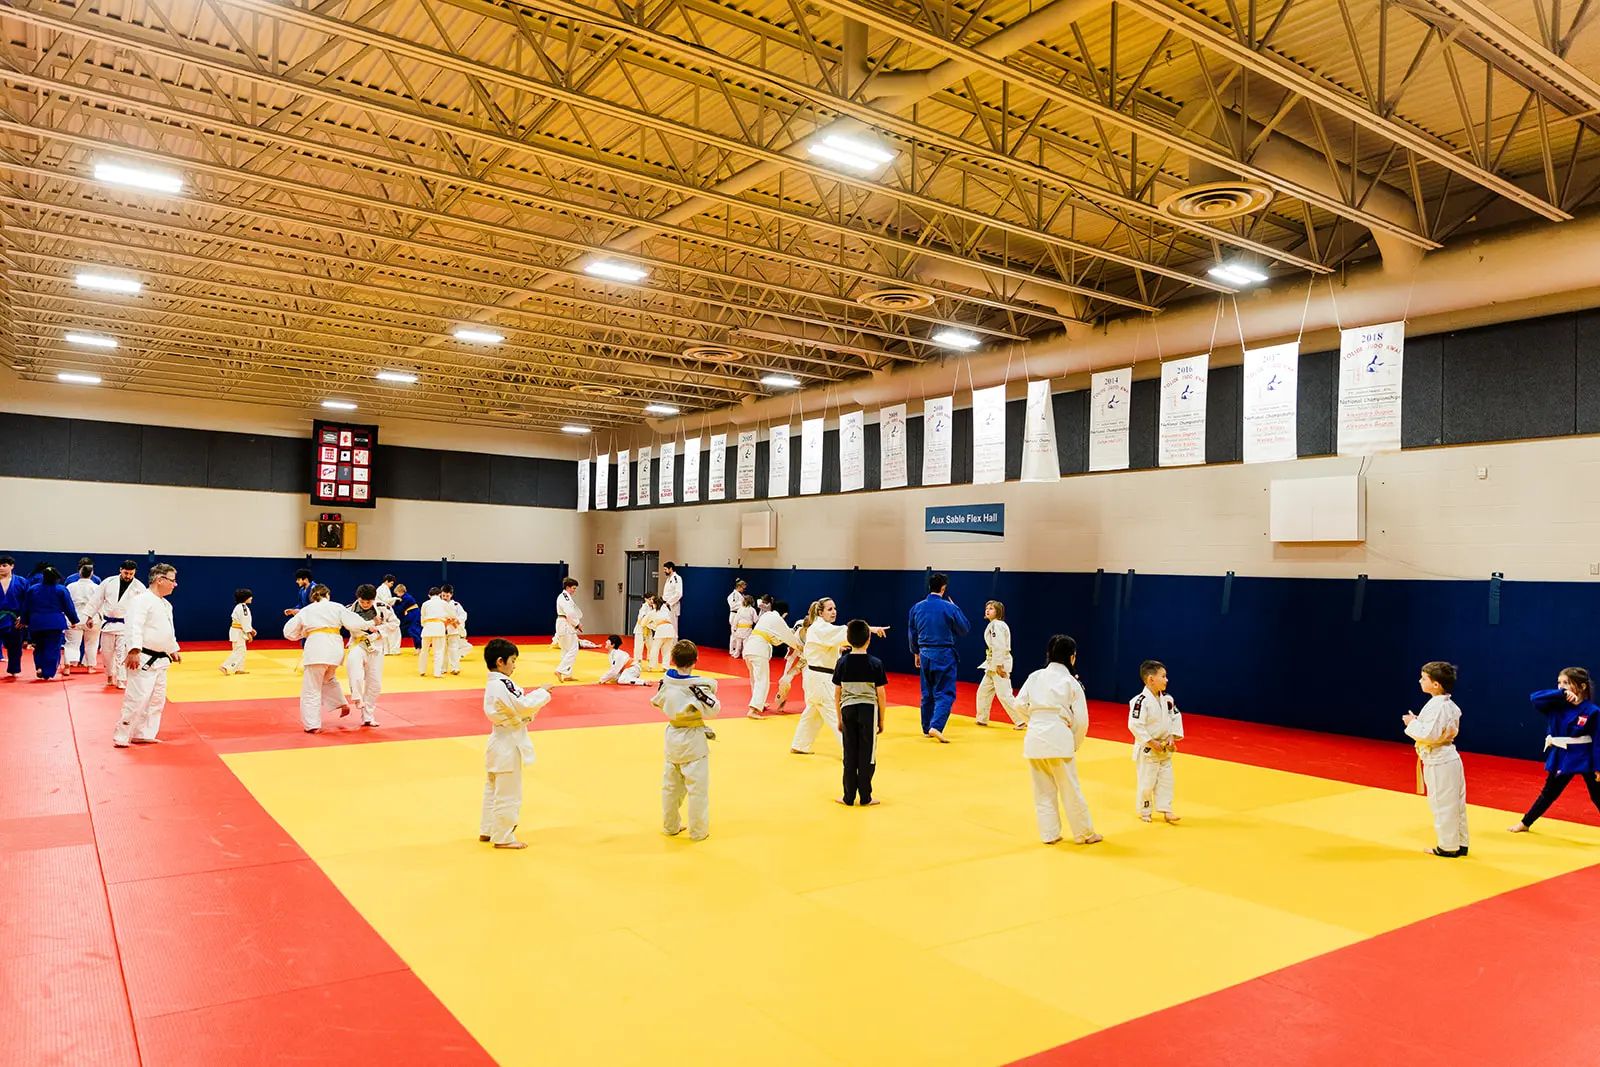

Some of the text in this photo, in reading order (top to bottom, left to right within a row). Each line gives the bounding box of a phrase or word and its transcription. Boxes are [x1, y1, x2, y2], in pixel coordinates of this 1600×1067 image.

[1361, 332, 1384, 343] 2018
[1177, 366, 1193, 375] 2016
[931, 512, 998, 525] Aux Sable Flex Hall
